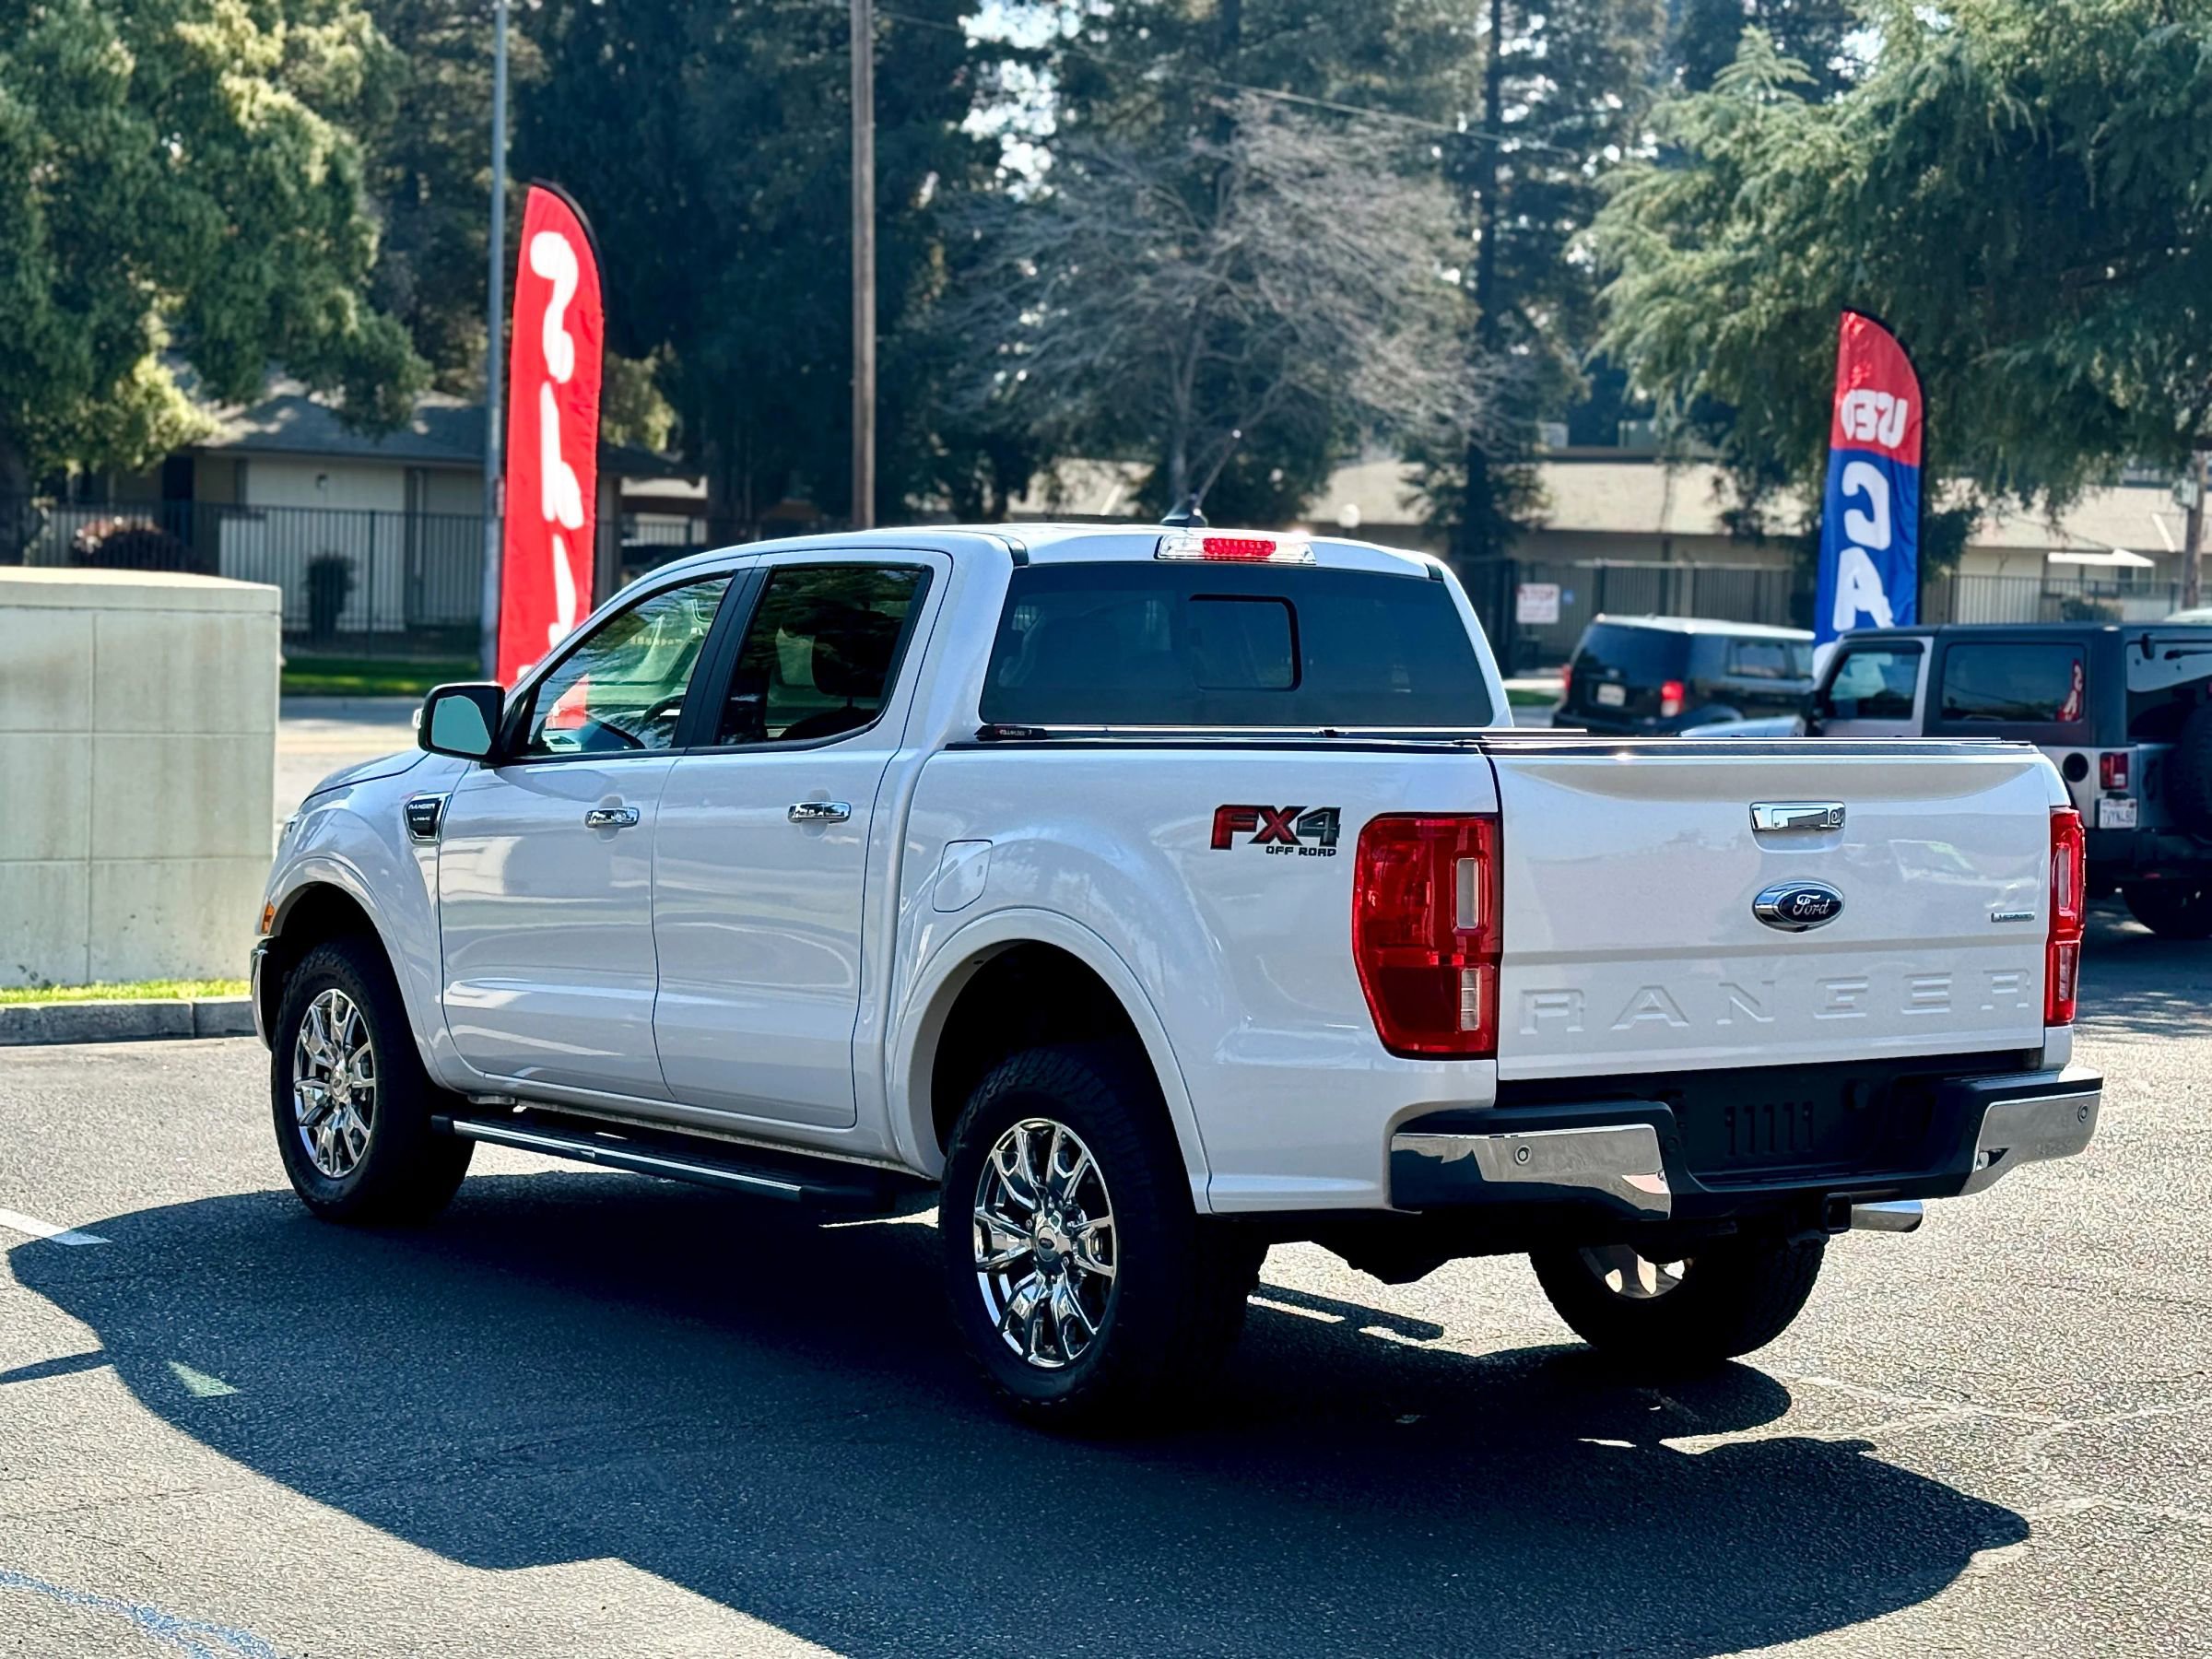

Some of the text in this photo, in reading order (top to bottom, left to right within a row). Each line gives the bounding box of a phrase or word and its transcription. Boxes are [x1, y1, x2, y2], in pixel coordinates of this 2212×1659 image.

[1210, 805, 1341, 850] FX4
[1265, 845, 1336, 857] OFF ROAD
[1792, 893, 1830, 916] Ford
[1521, 969, 2030, 1035] RANGER
